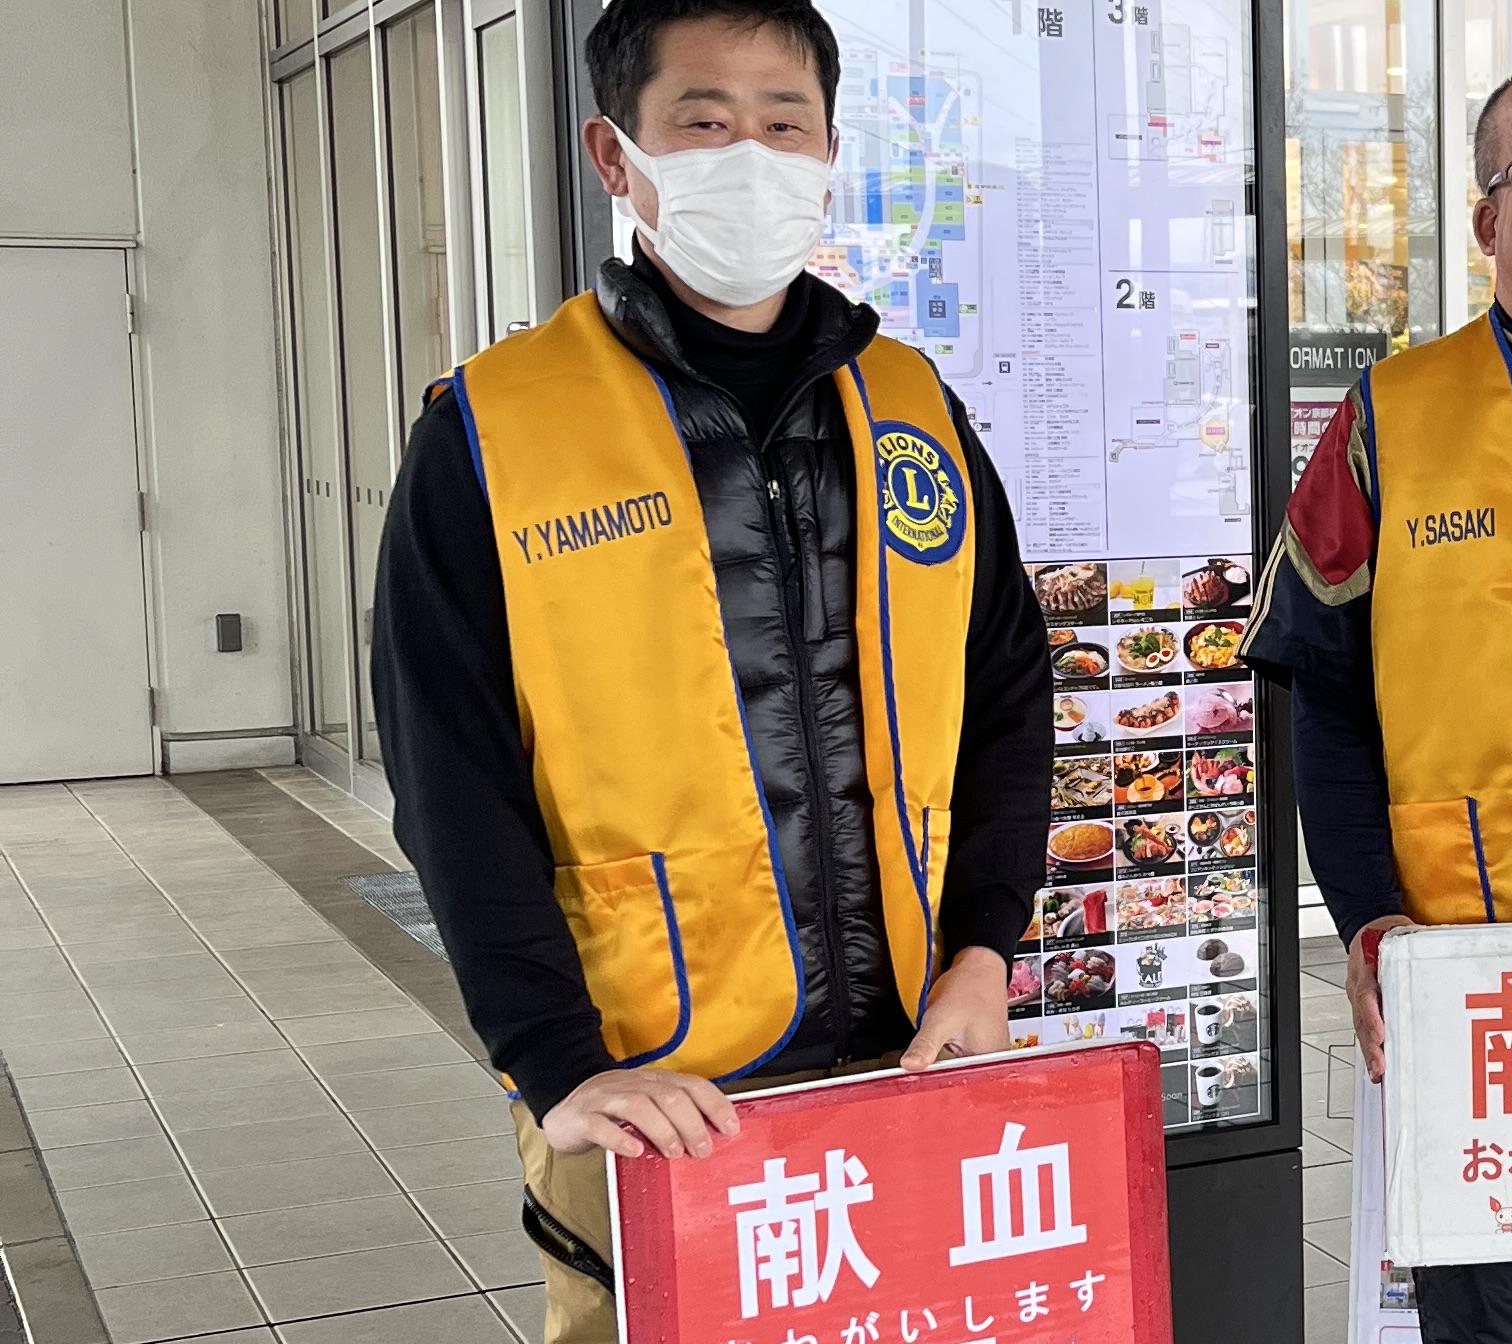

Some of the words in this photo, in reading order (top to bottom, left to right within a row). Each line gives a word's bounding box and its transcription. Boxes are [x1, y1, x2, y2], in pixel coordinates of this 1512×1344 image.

[1115, 278, 1156, 310] 2階
[880, 435, 936, 465] LIONS
[901, 467, 931, 511] L
[512, 491, 673, 564] Y.YAMAMOTO
[892, 515, 945, 543] INTERNATIONAL
[1406, 507, 1496, 549] Y.SASAKI
